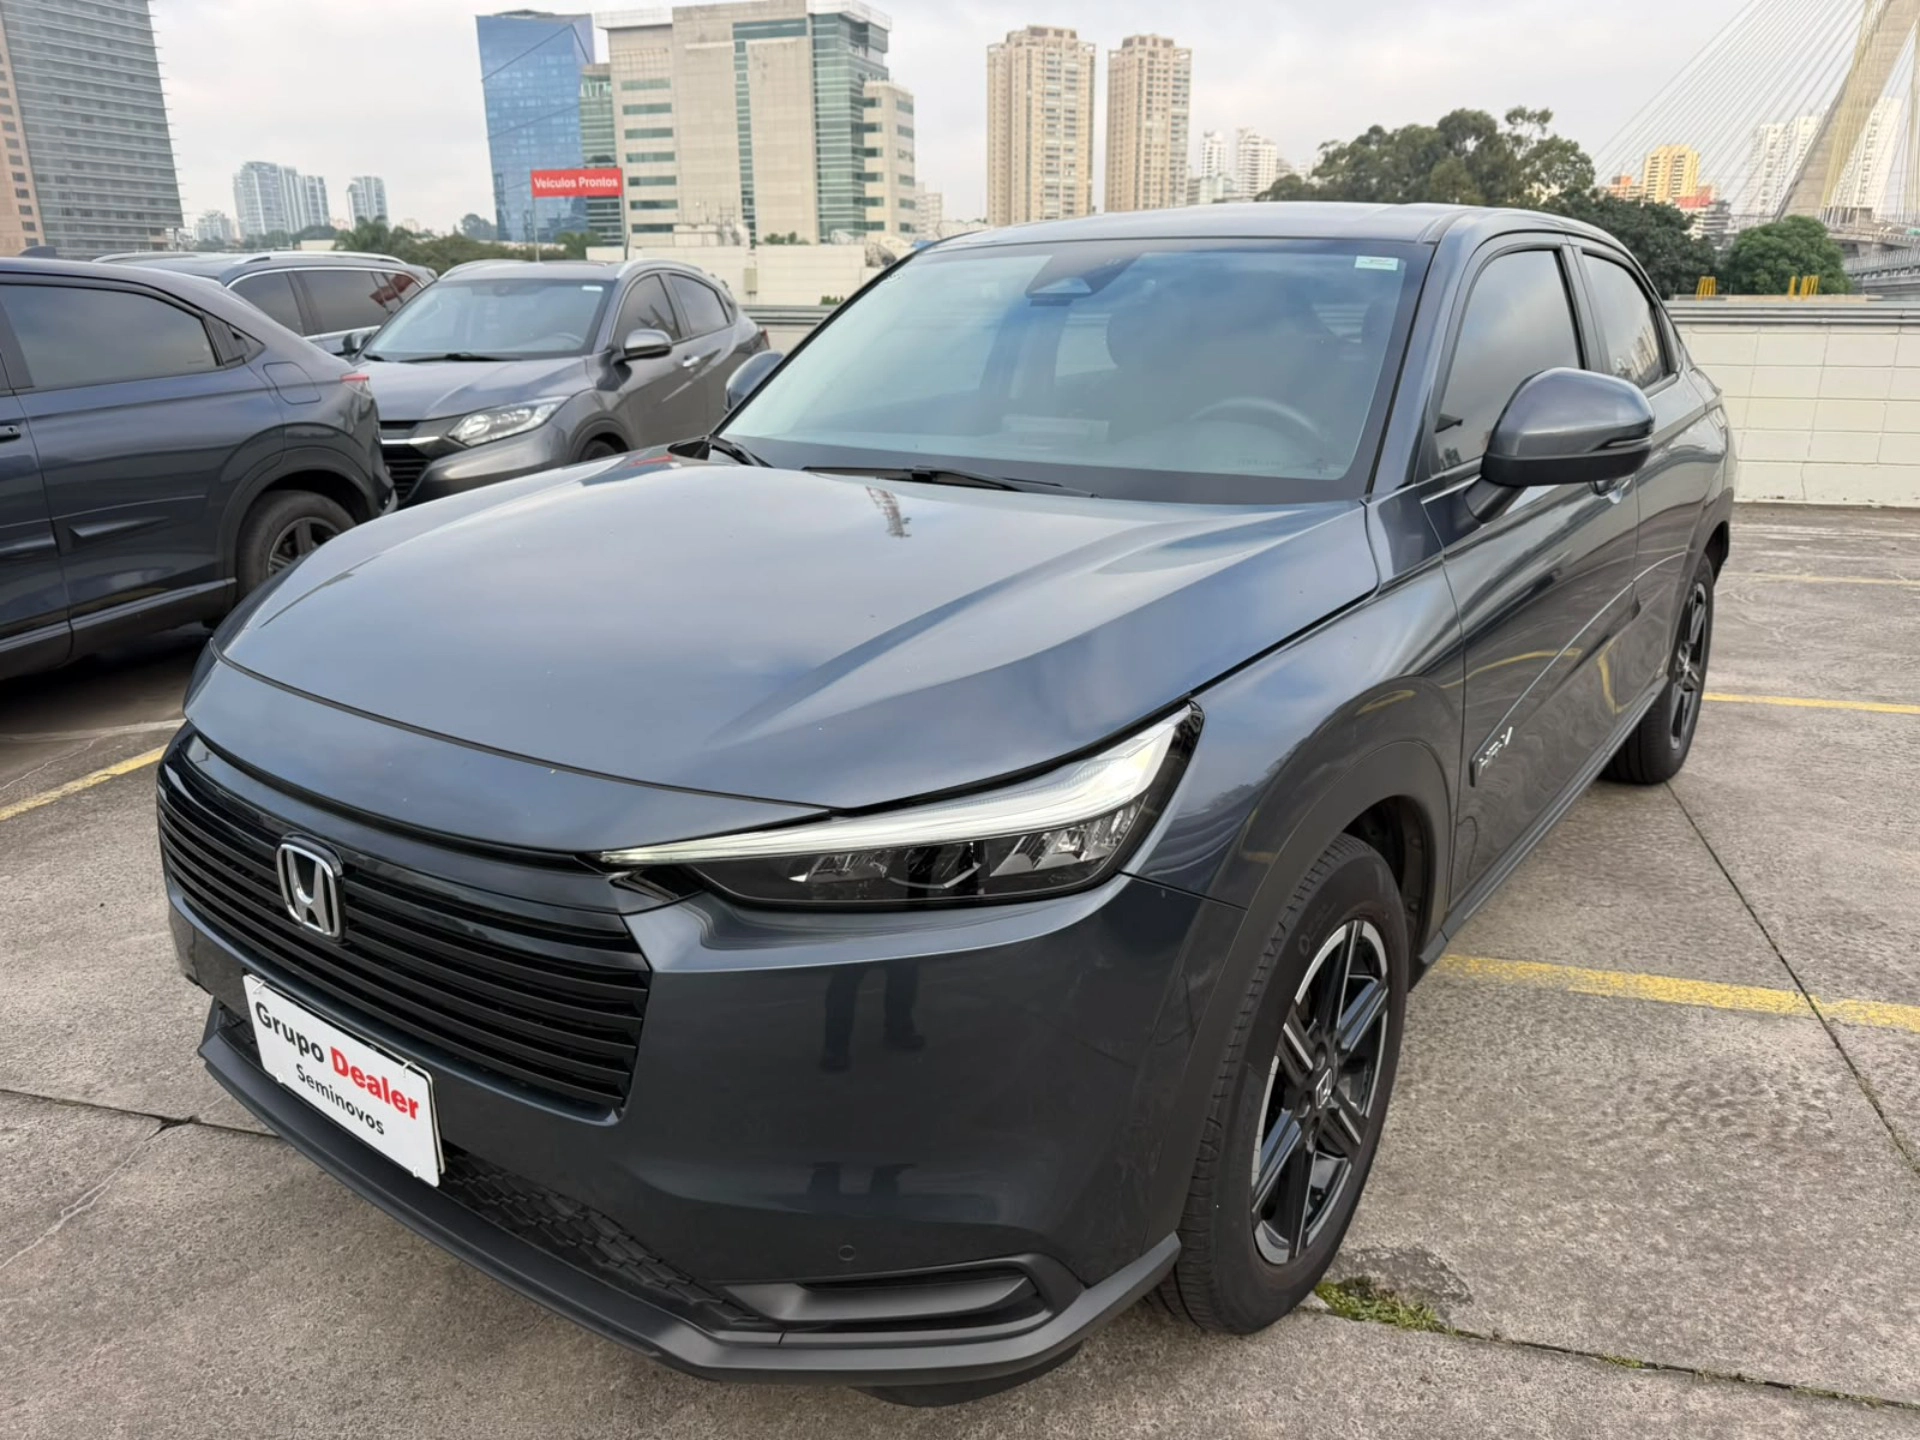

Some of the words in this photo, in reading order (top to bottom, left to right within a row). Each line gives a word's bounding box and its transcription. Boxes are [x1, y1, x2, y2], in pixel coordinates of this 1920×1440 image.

[578, 176, 618, 188] Prontos
[255, 1001, 325, 1063] Grupo
[330, 1046, 419, 1120] Dealer
[296, 1063, 385, 1135] Seminovos
